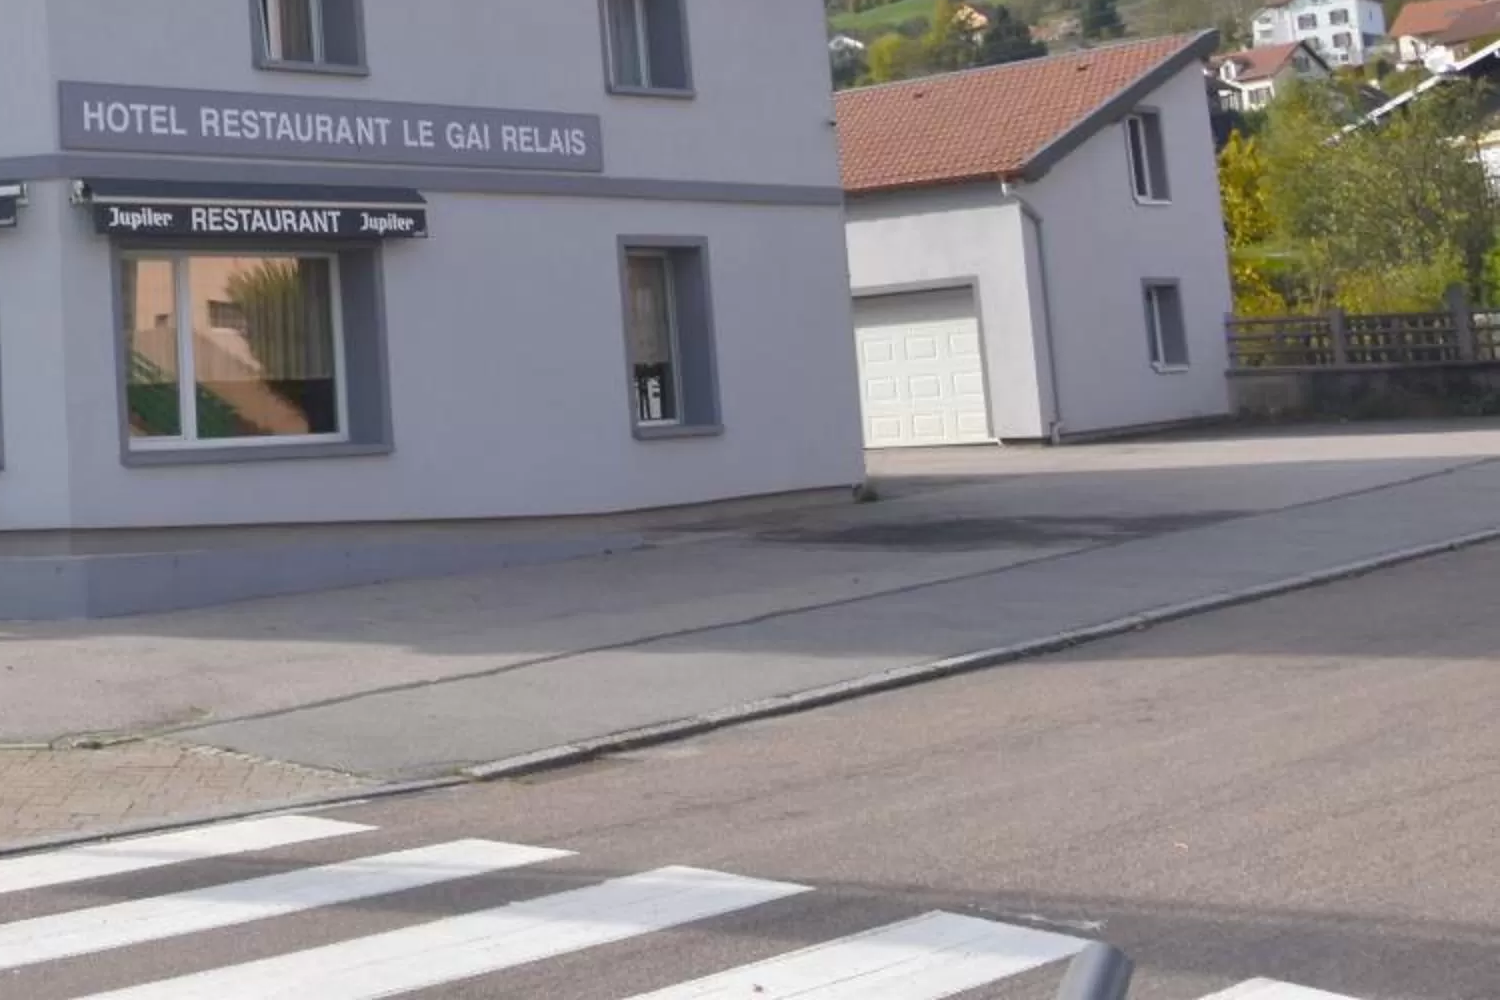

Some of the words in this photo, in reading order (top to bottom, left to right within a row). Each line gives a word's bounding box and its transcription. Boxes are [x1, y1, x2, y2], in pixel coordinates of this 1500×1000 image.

[83, 100, 188, 136] HOTEL
[200, 107, 391, 146] RESTAURANT
[403, 119, 435, 148] LE
[446, 121, 491, 150] GAI
[502, 125, 587, 156] RELAIS
[191, 207, 341, 233] RESTAURANT
